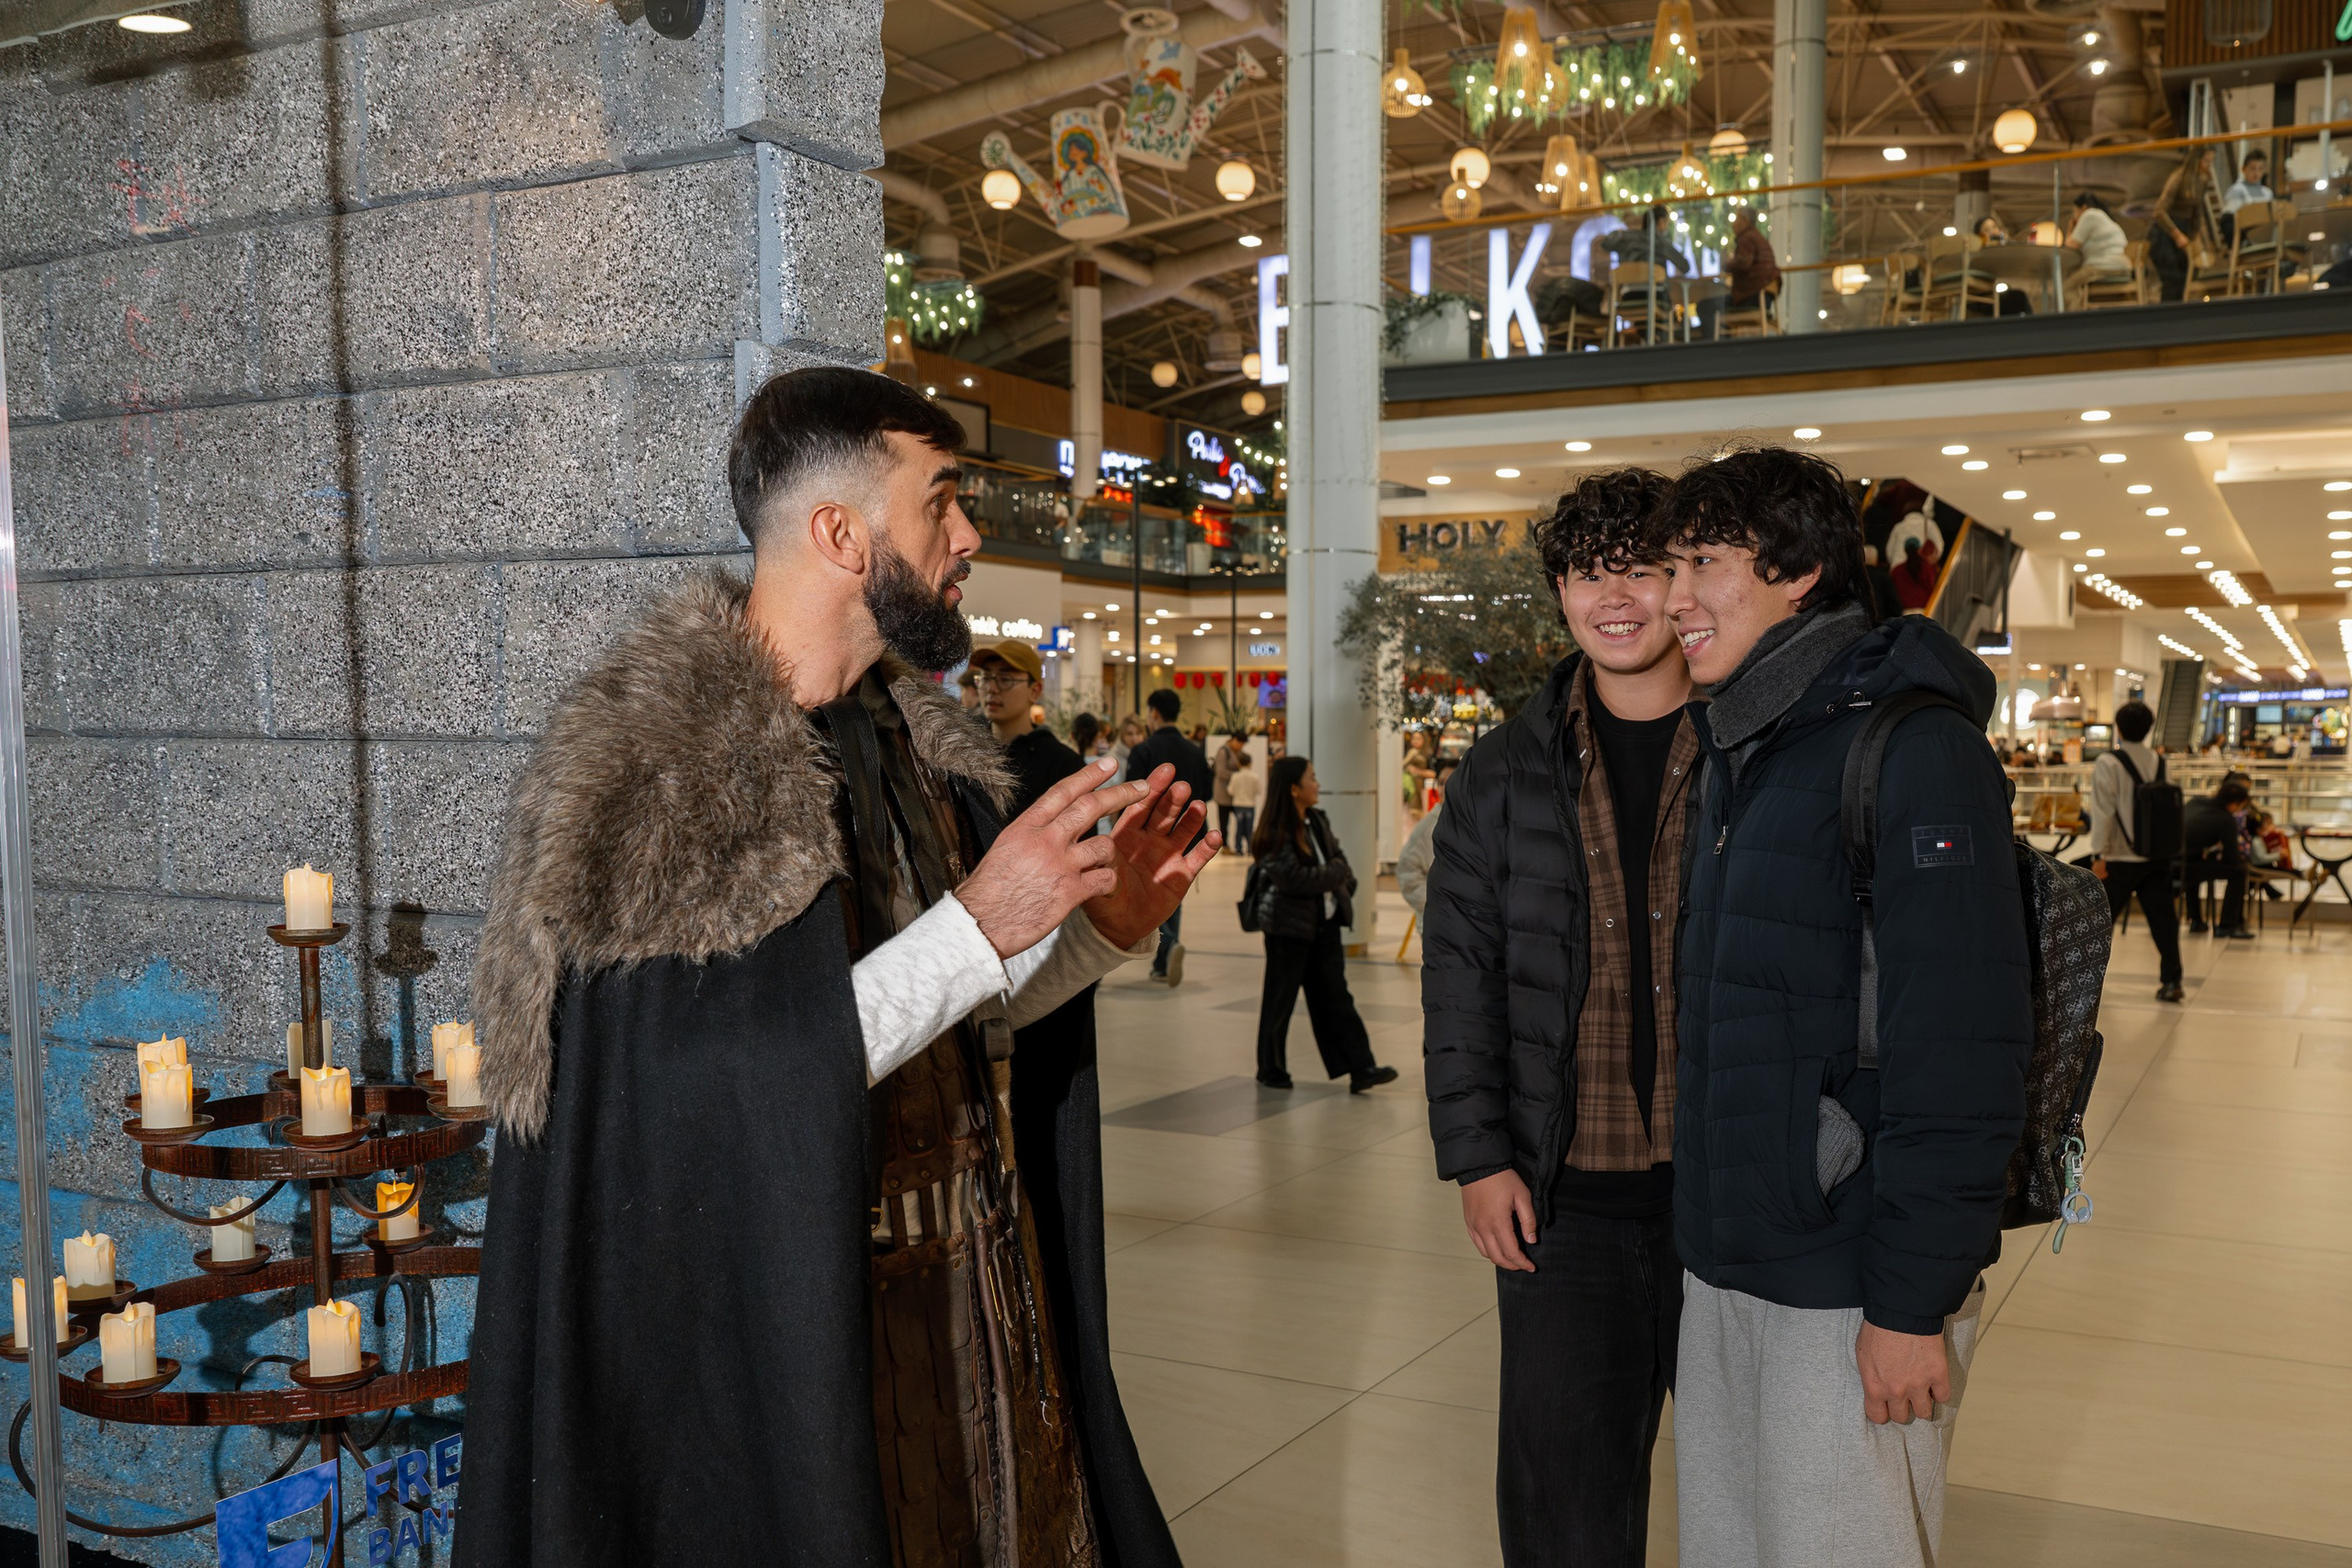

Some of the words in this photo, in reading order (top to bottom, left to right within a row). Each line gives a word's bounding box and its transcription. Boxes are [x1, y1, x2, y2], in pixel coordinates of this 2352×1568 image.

[1398, 519, 1506, 552] HOLY
[365, 1433, 462, 1517] FRE
[368, 1497, 458, 1568] BAN
